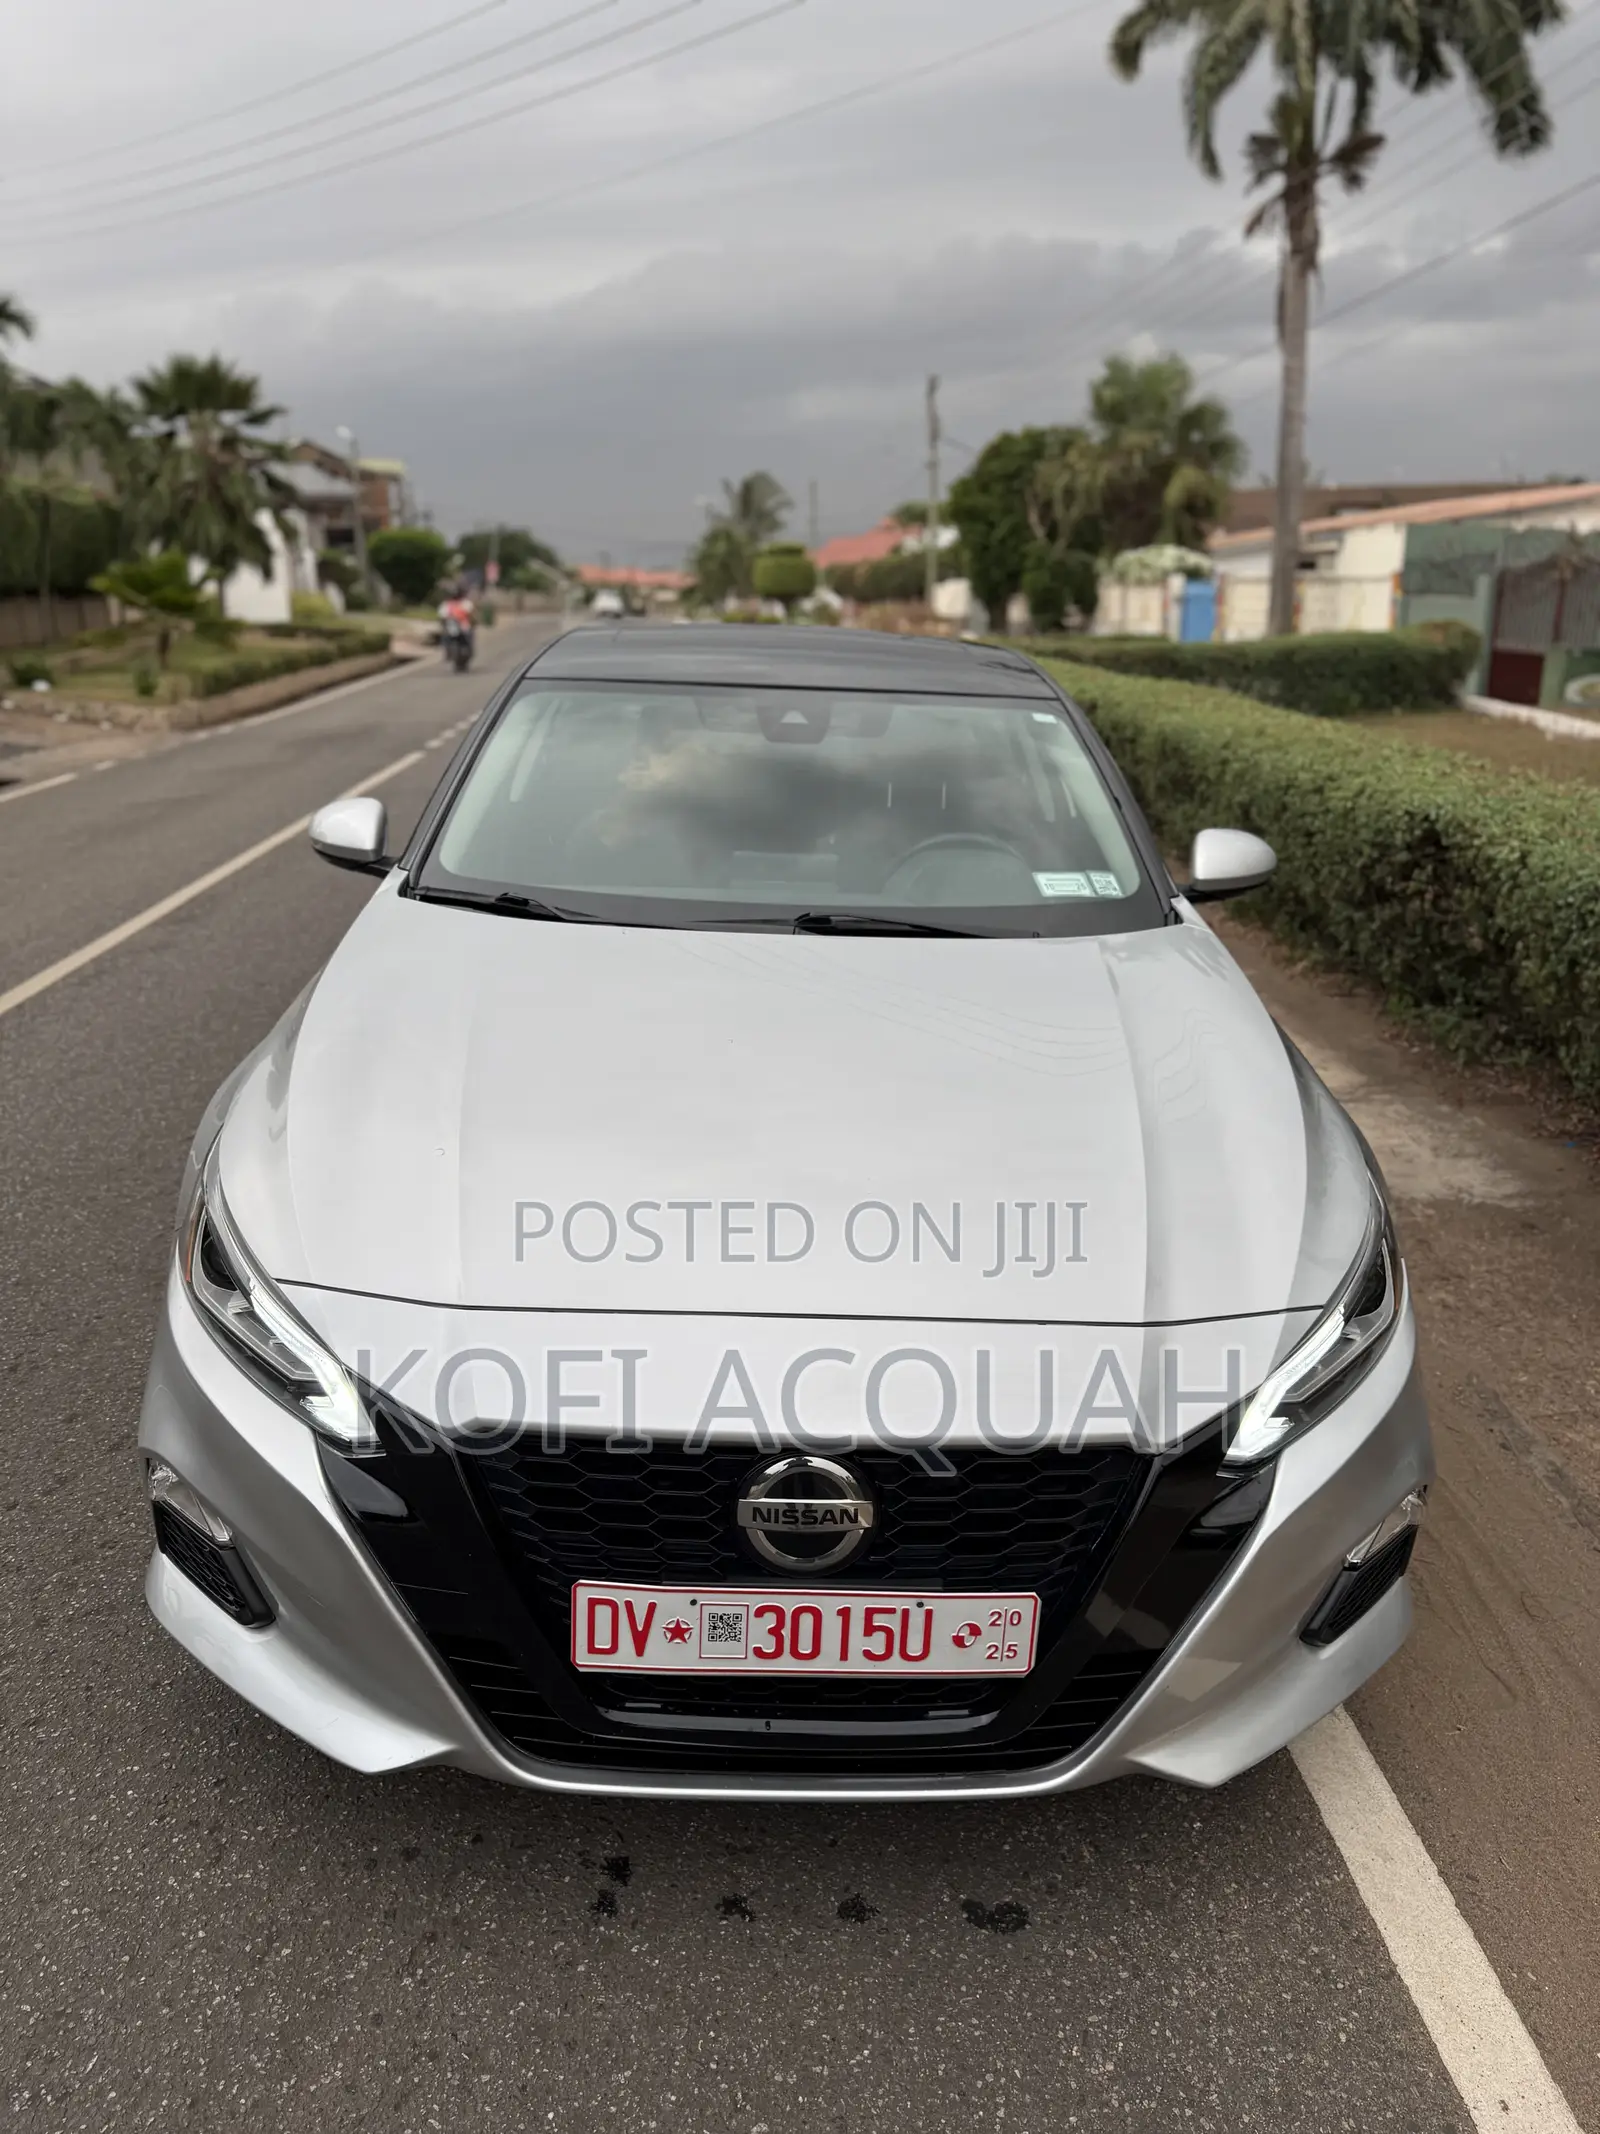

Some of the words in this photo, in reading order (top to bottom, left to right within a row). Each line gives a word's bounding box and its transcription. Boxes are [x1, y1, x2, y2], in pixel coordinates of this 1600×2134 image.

[752, 1507, 859, 1526] NISSAN
[988, 1609, 1022, 1627] 20
[586, 1596, 657, 1657] DV
[752, 1603, 934, 1662] 3015U
[985, 1642, 1019, 1660] 25
